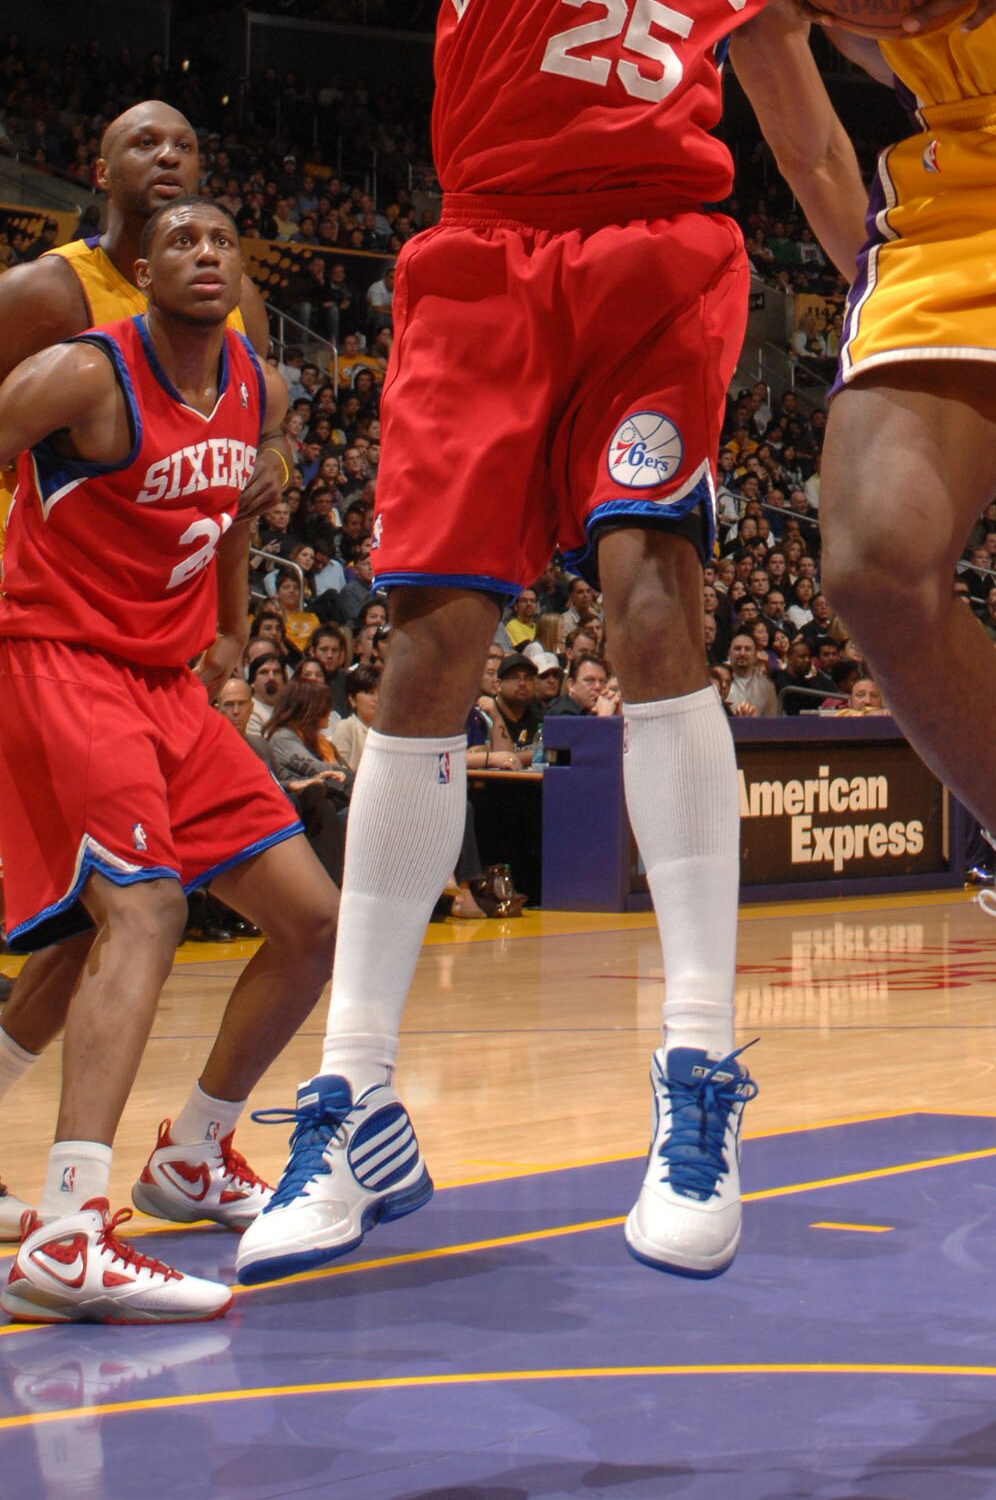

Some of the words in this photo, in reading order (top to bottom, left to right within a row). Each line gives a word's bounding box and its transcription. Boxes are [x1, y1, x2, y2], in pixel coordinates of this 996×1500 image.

[136, 438, 258, 502] SIXERS
[613, 440, 669, 472] 76ers
[791, 815, 924, 872] Express
